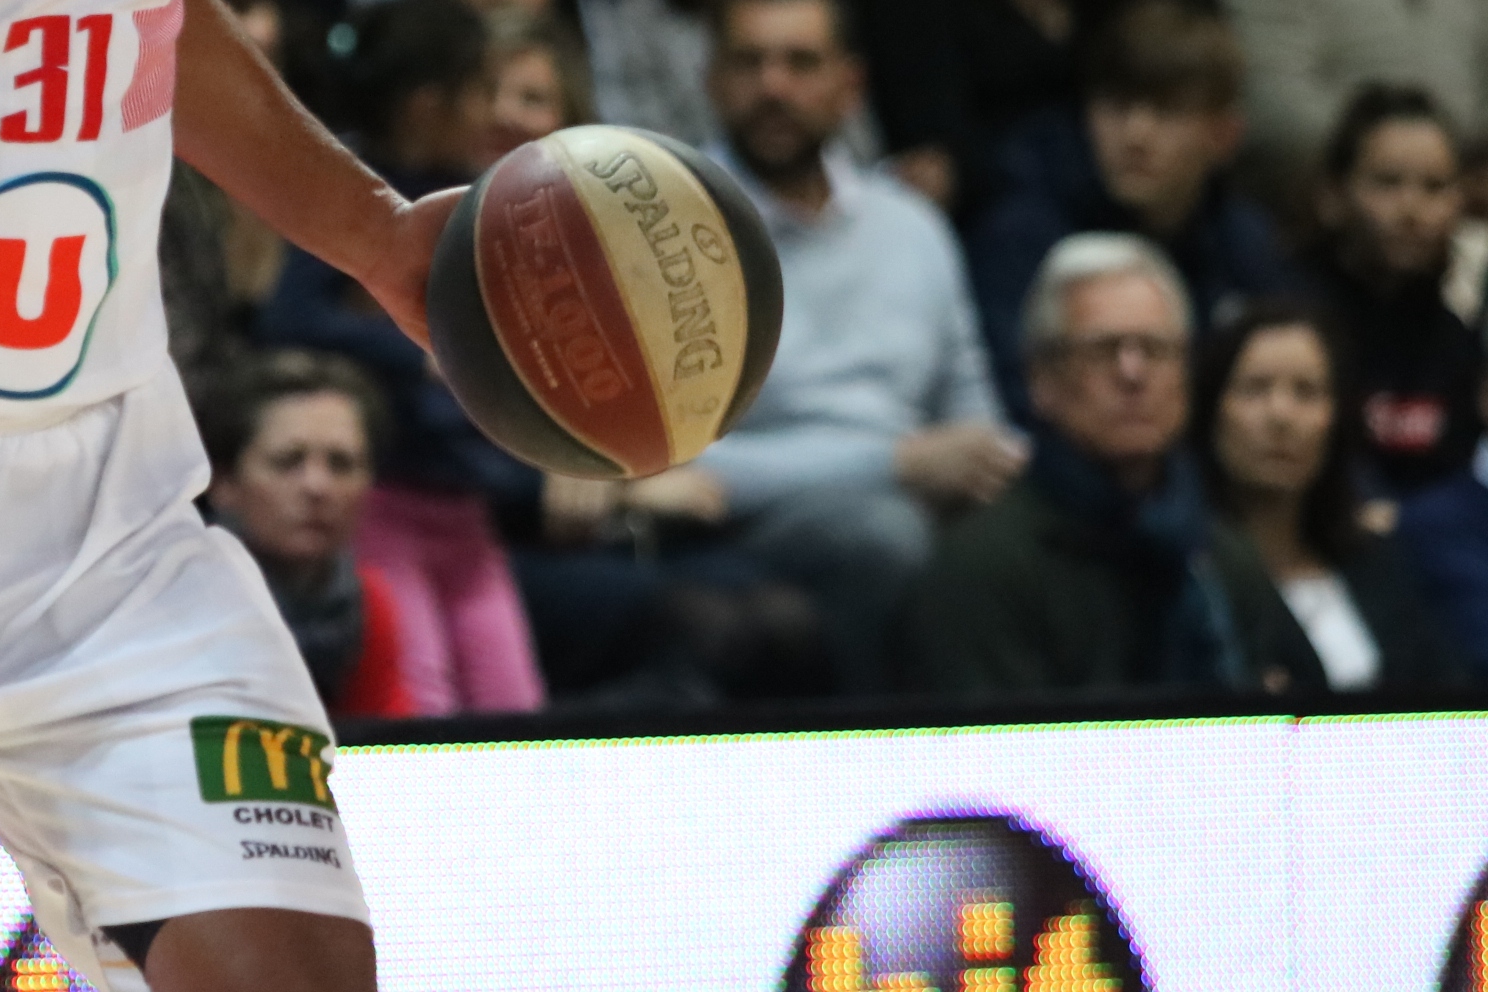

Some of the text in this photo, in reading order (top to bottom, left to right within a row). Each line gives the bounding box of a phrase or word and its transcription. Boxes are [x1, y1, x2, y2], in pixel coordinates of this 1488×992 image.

[586, 150, 723, 381] SPALDING
[233, 807, 334, 832] CHOLET
[241, 840, 341, 868] SPALDING
